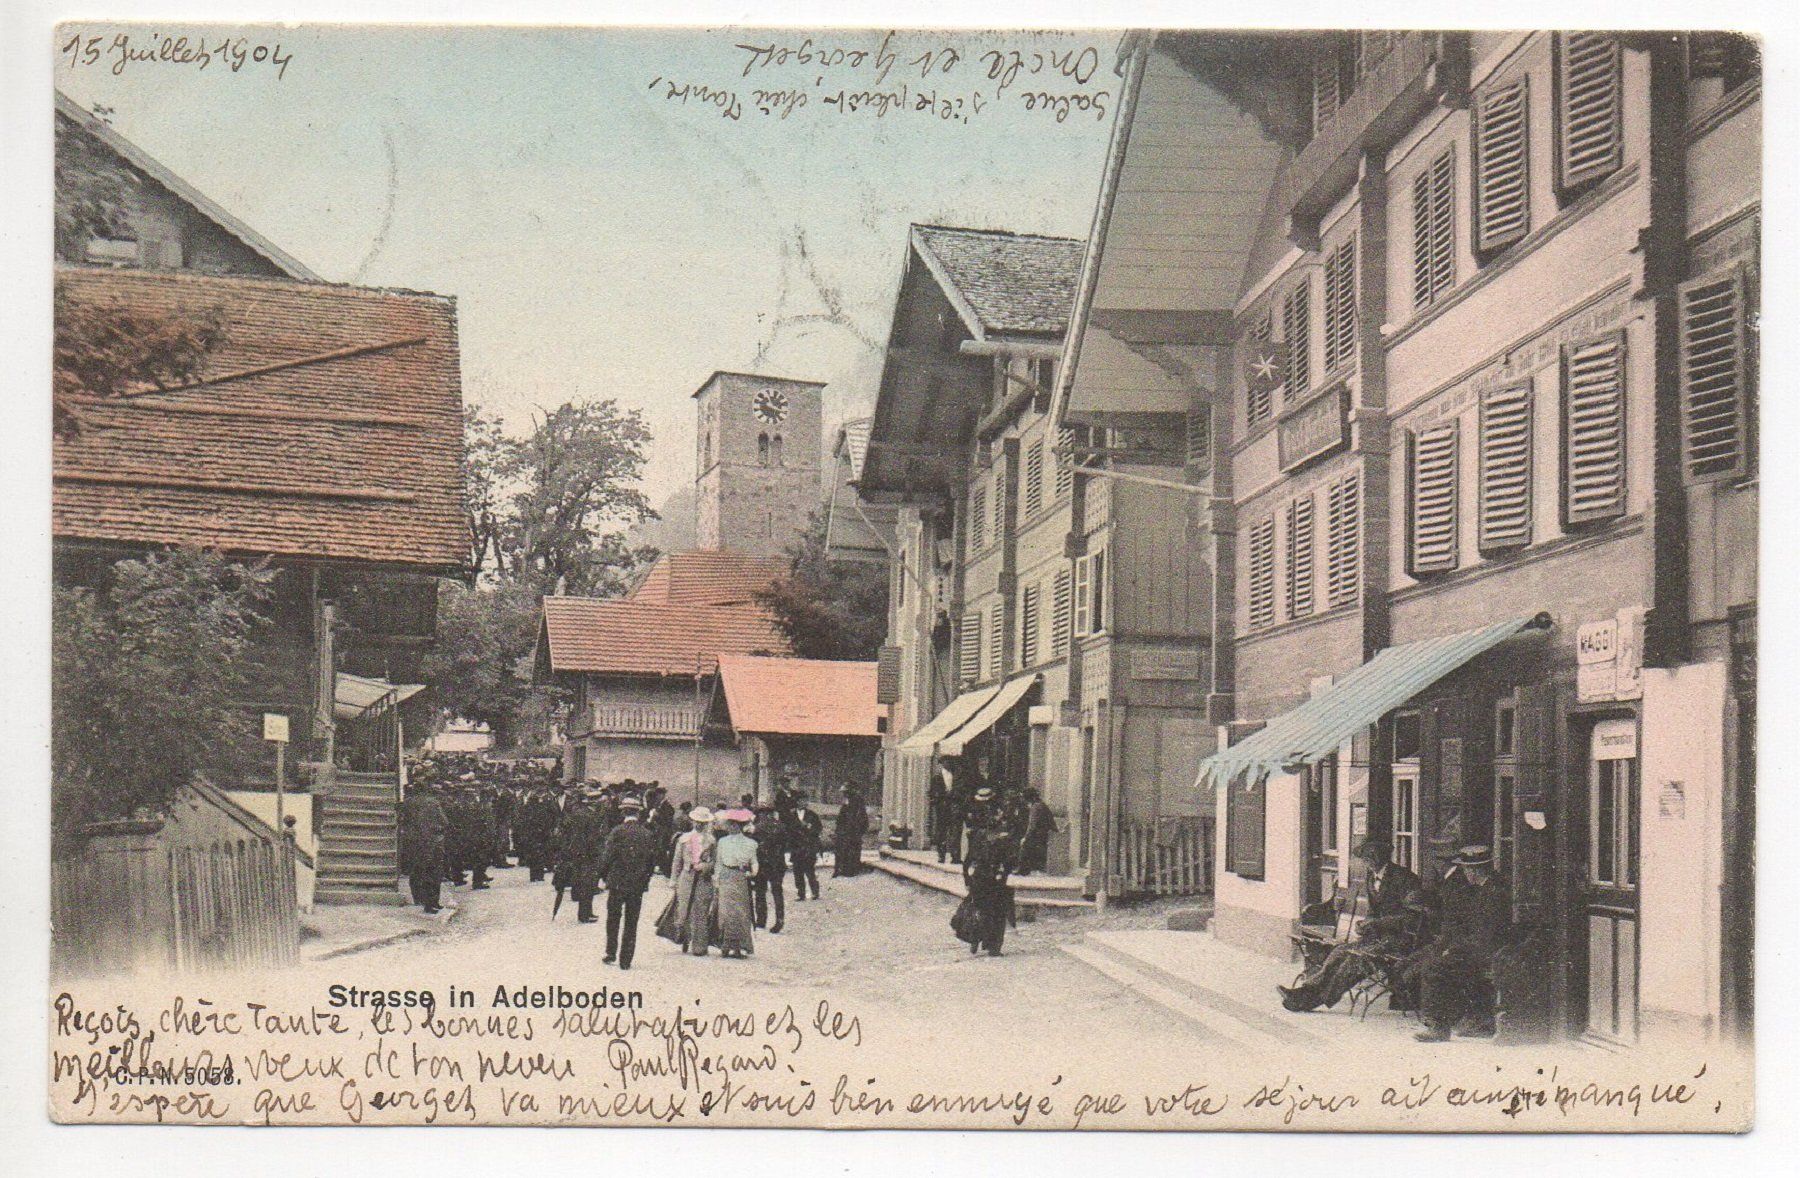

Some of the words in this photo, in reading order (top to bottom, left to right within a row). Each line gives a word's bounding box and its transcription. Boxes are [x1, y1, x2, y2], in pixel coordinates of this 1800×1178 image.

[63, 34, 103, 68] 15
[213, 38, 293, 80] 1904
[254, 1090, 317, 1125] que
[558, 1083, 688, 1122] mieux
[1073, 1092, 1127, 1129] que
